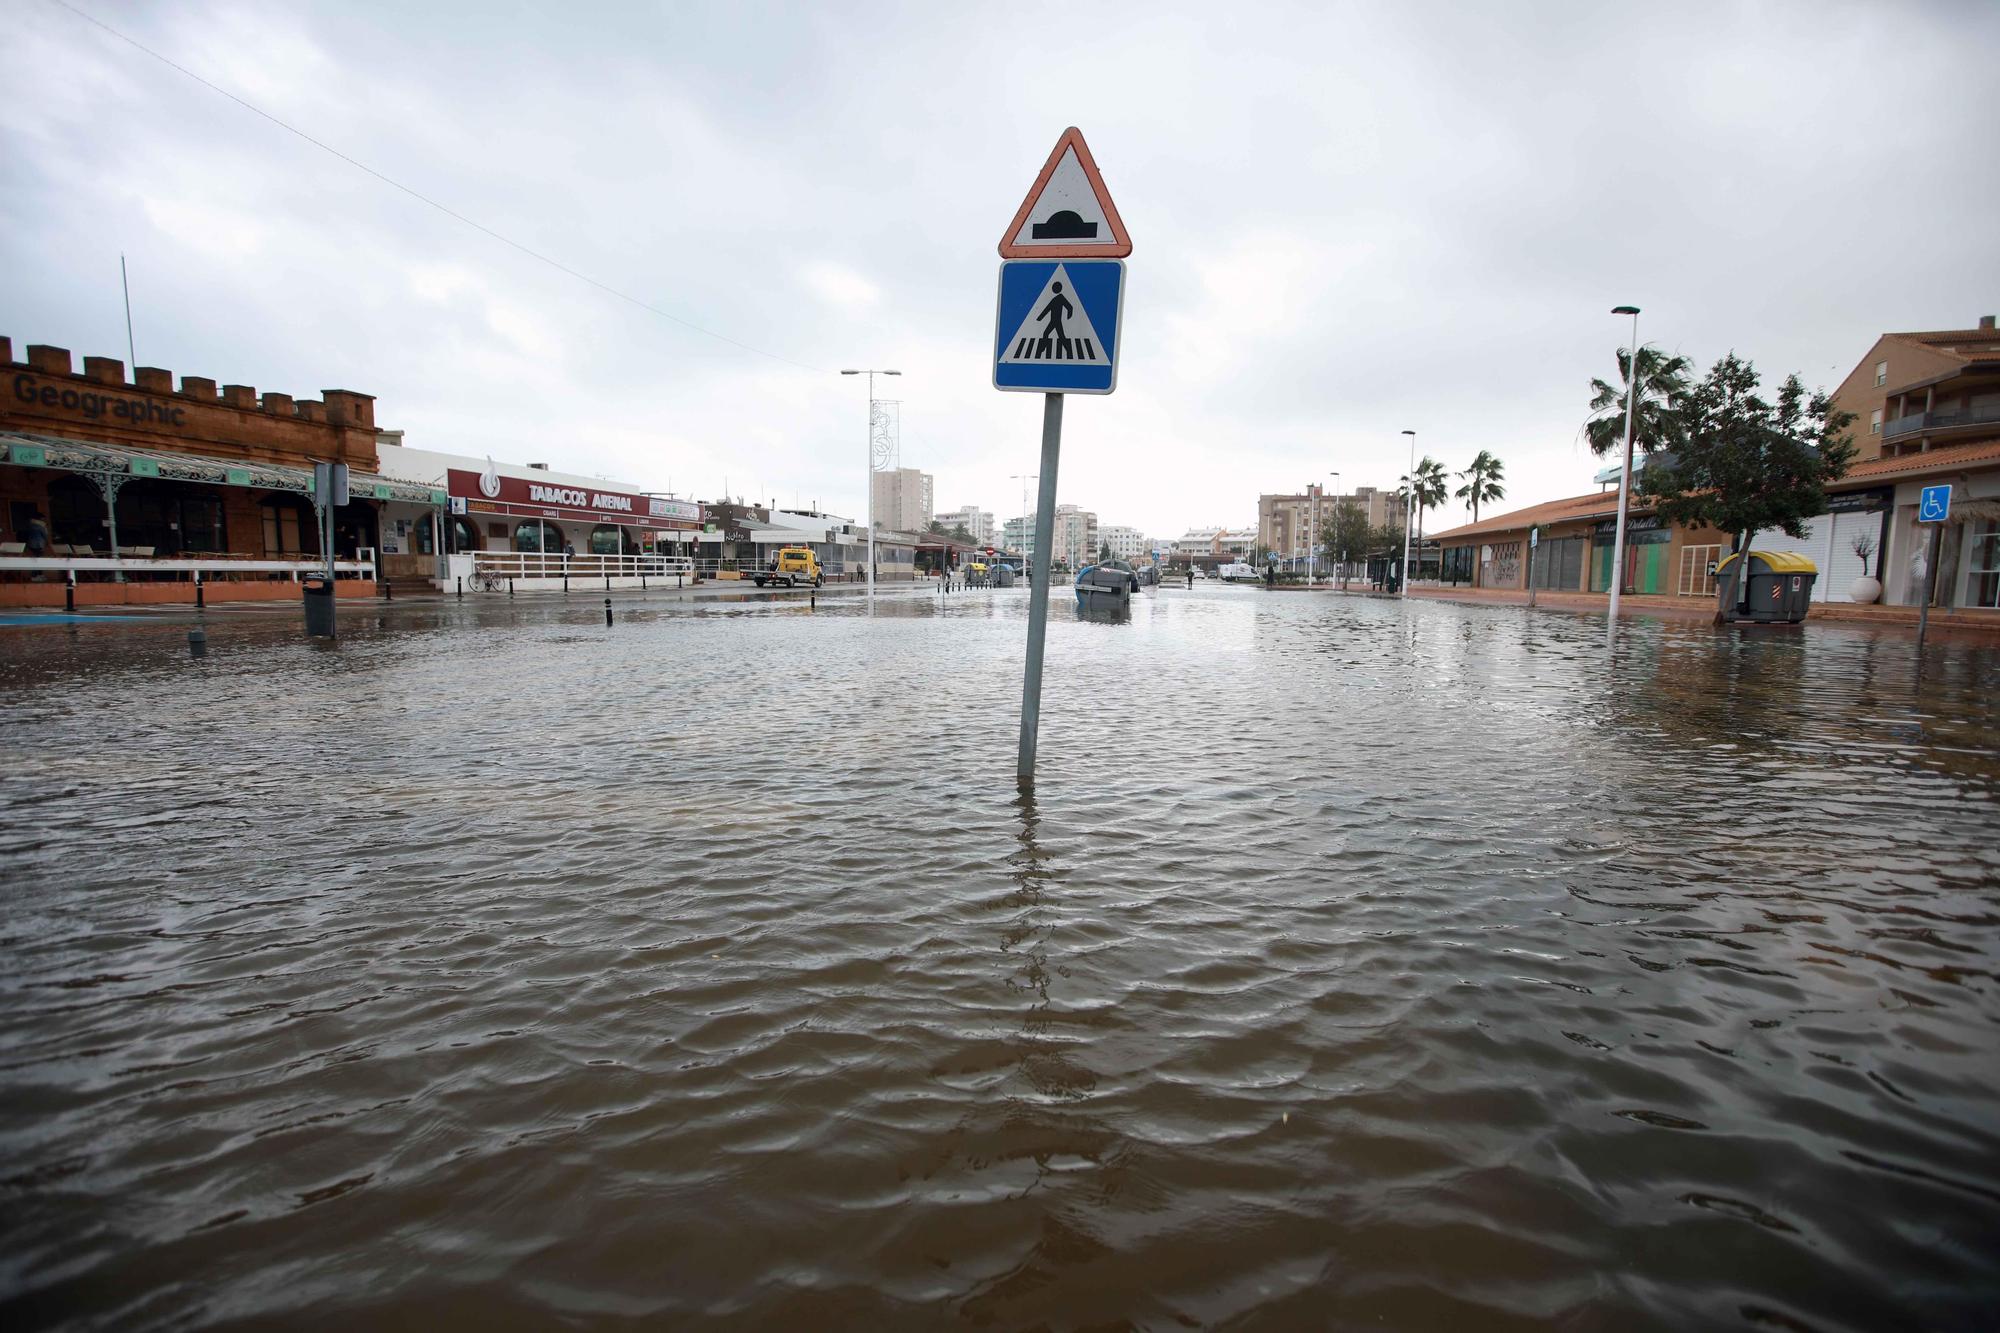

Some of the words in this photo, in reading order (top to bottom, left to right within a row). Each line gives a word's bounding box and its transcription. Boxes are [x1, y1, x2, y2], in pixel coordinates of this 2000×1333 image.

[13, 373, 186, 426] Geographic
[528, 484, 587, 507] TABACOS
[591, 493, 632, 512] ARENAL
